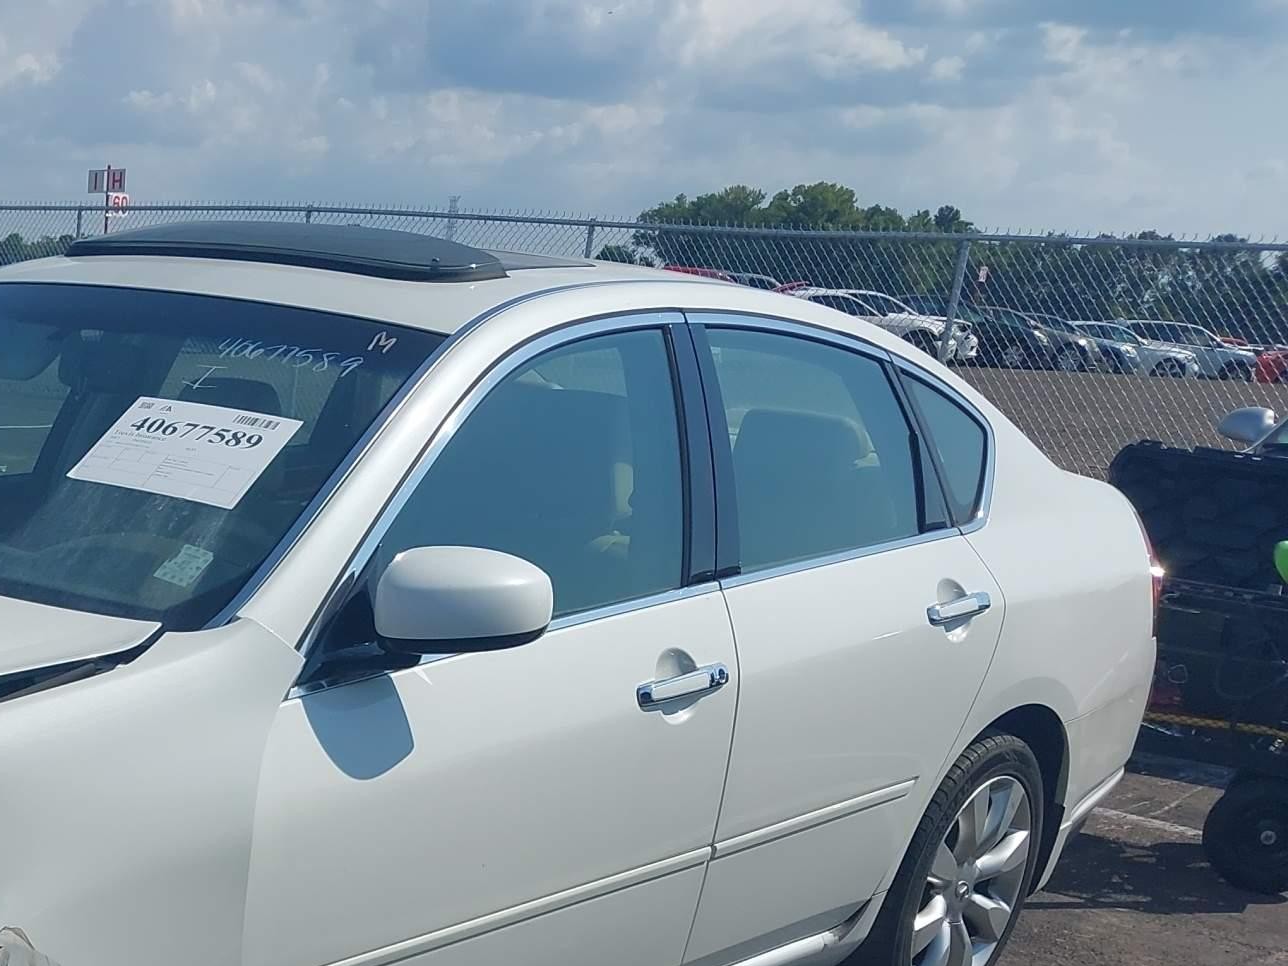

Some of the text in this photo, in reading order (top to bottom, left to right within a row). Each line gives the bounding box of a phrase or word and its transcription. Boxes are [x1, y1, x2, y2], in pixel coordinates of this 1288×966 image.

[112, 171, 123, 190] H
[218, 337, 364, 377] 40677589
[130, 415, 265, 450] 40677589
